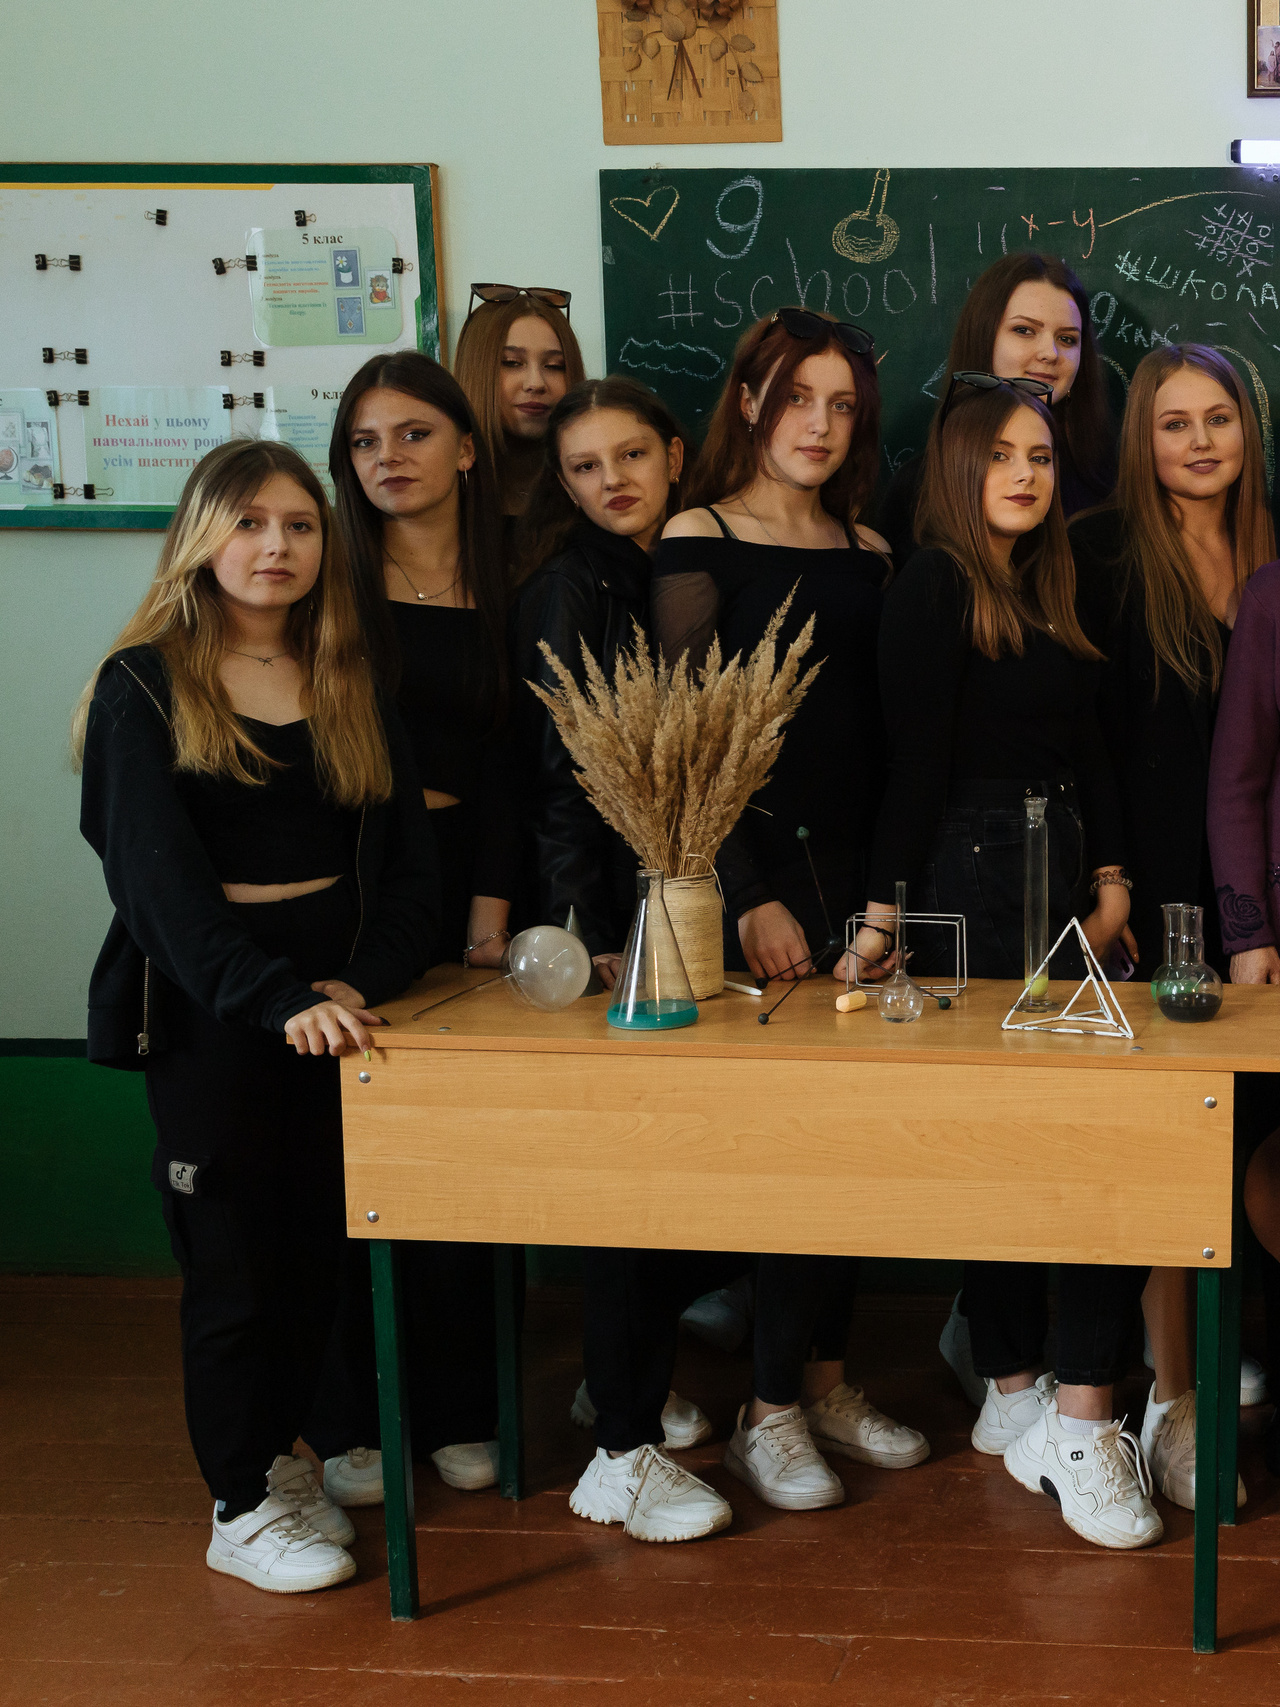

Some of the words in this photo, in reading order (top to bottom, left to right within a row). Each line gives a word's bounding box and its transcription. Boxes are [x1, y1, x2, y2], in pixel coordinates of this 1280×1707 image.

[706, 174, 763, 260] 9
[302, 233, 309, 245] 5
[313, 235, 343, 245] клас
[311, 388, 318, 400] 9
[323, 391, 344, 400] кла
[105, 414, 149, 427] Нехай
[154, 418, 160, 430] у
[166, 418, 210, 430] цьому
[93, 437, 188, 450] навчальному
[194, 435, 223, 450] році
[103, 455, 133, 470] усім
